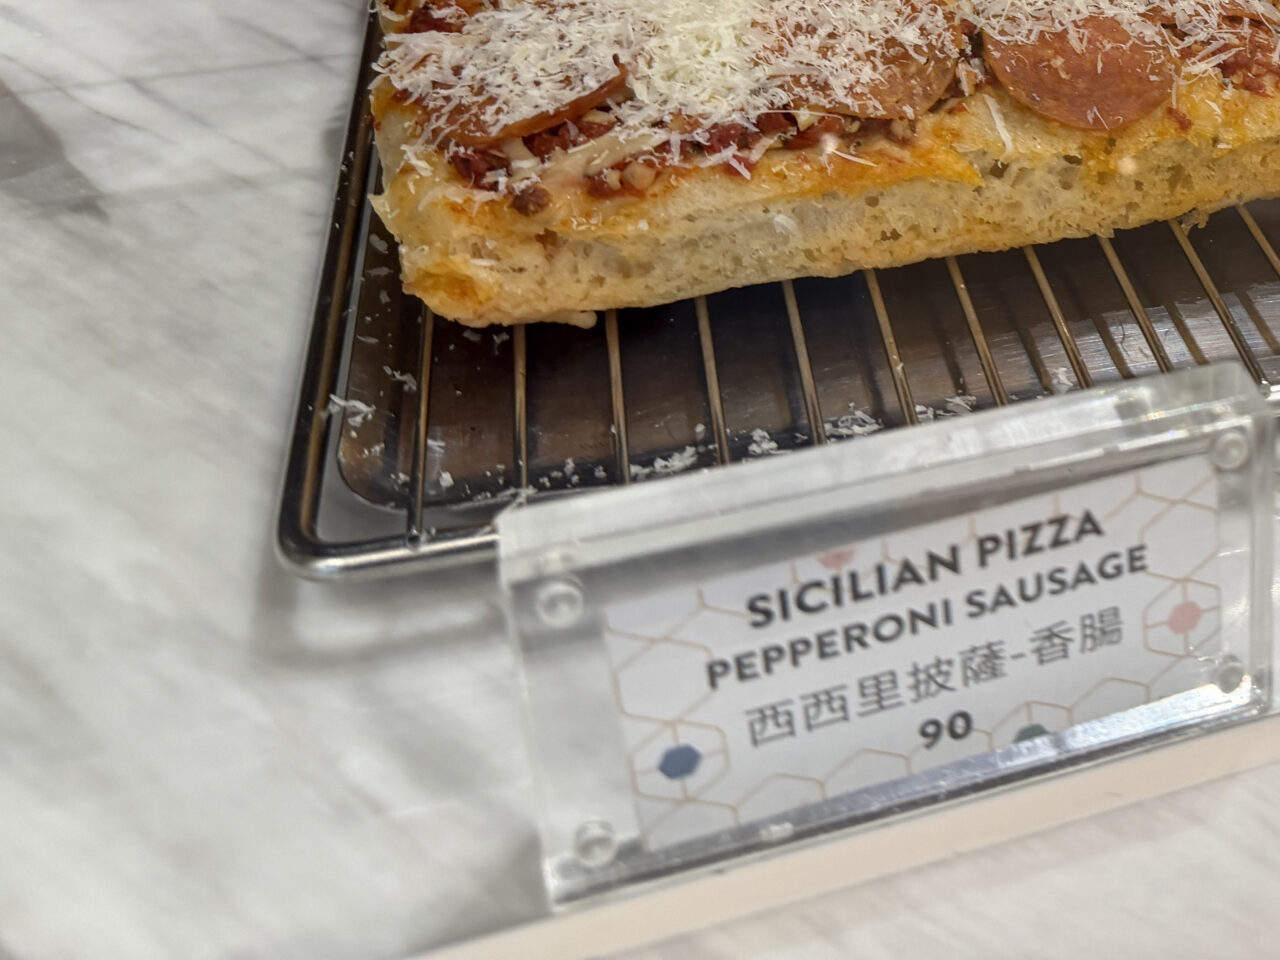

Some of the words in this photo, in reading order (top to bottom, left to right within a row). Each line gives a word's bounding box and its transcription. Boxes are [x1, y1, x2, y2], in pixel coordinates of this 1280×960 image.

[706, 599, 953, 691] PEPPERONI
[964, 544, 1149, 620] SAUSAGE
[746, 543, 962, 629] SICILIAN
[977, 509, 1105, 568] PIZZA
[744, 605, 1125, 748] 西西里披薩-香腸
[918, 710, 974, 750] 90
